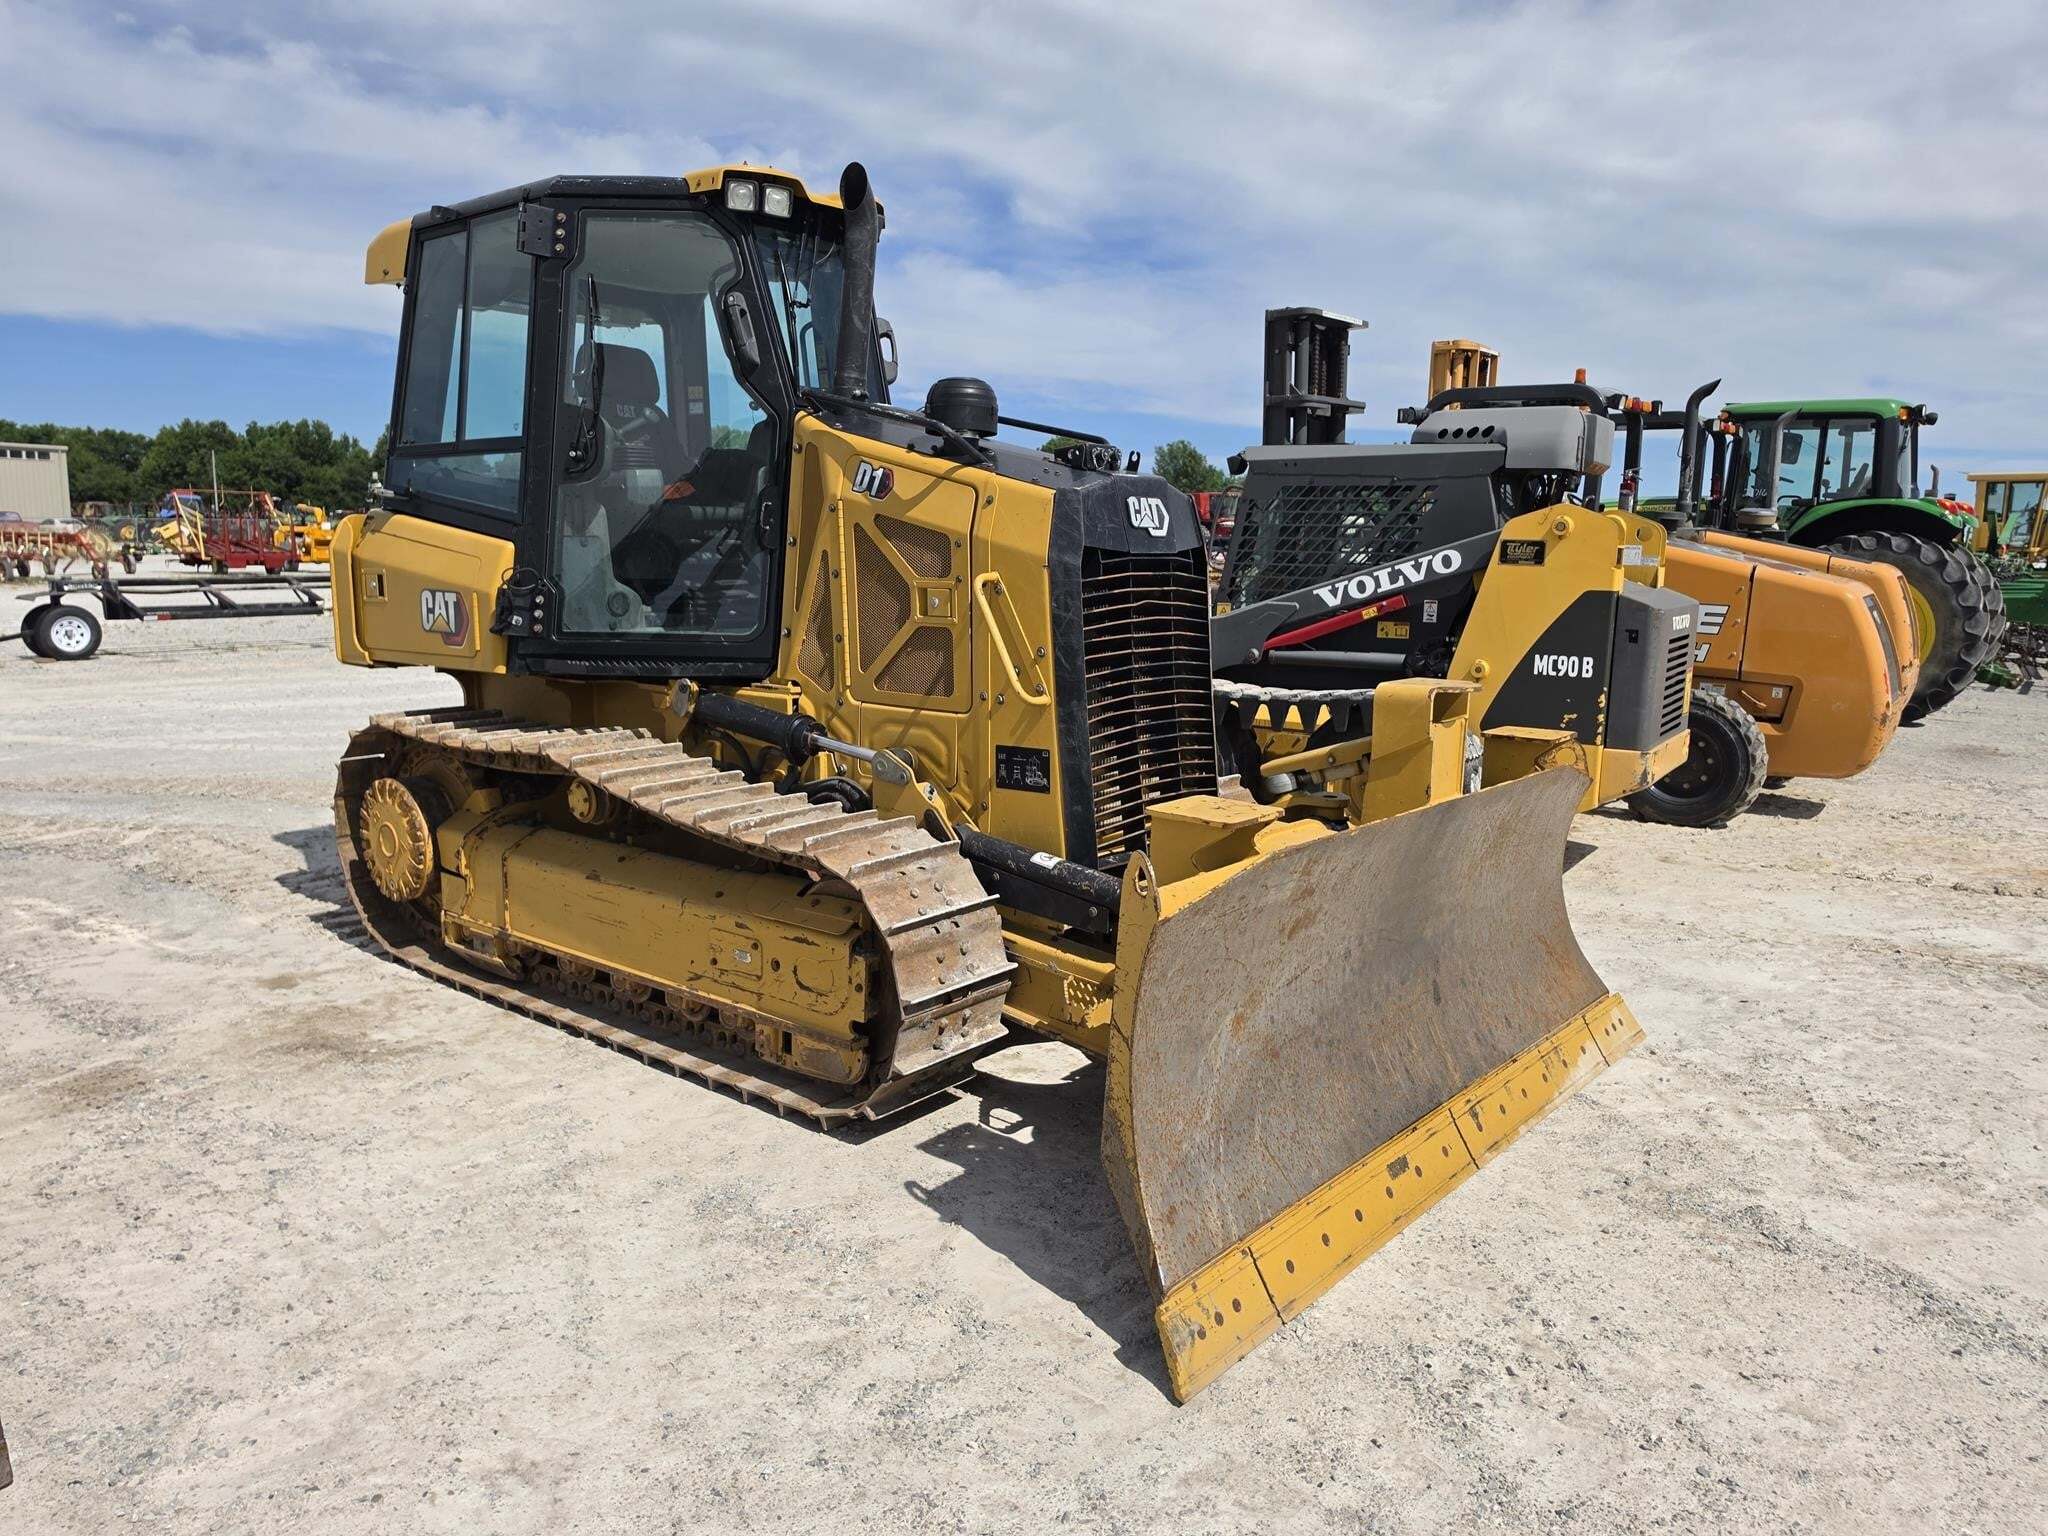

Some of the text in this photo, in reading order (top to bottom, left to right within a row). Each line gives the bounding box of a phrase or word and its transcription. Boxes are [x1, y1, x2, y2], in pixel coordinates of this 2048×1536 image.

[852, 461, 884, 497] D1
[1126, 496, 1161, 529] CAT
[1313, 549, 1462, 607] VOLVO
[421, 590, 457, 633] CAT
[1533, 654, 1594, 678] MC90 B
